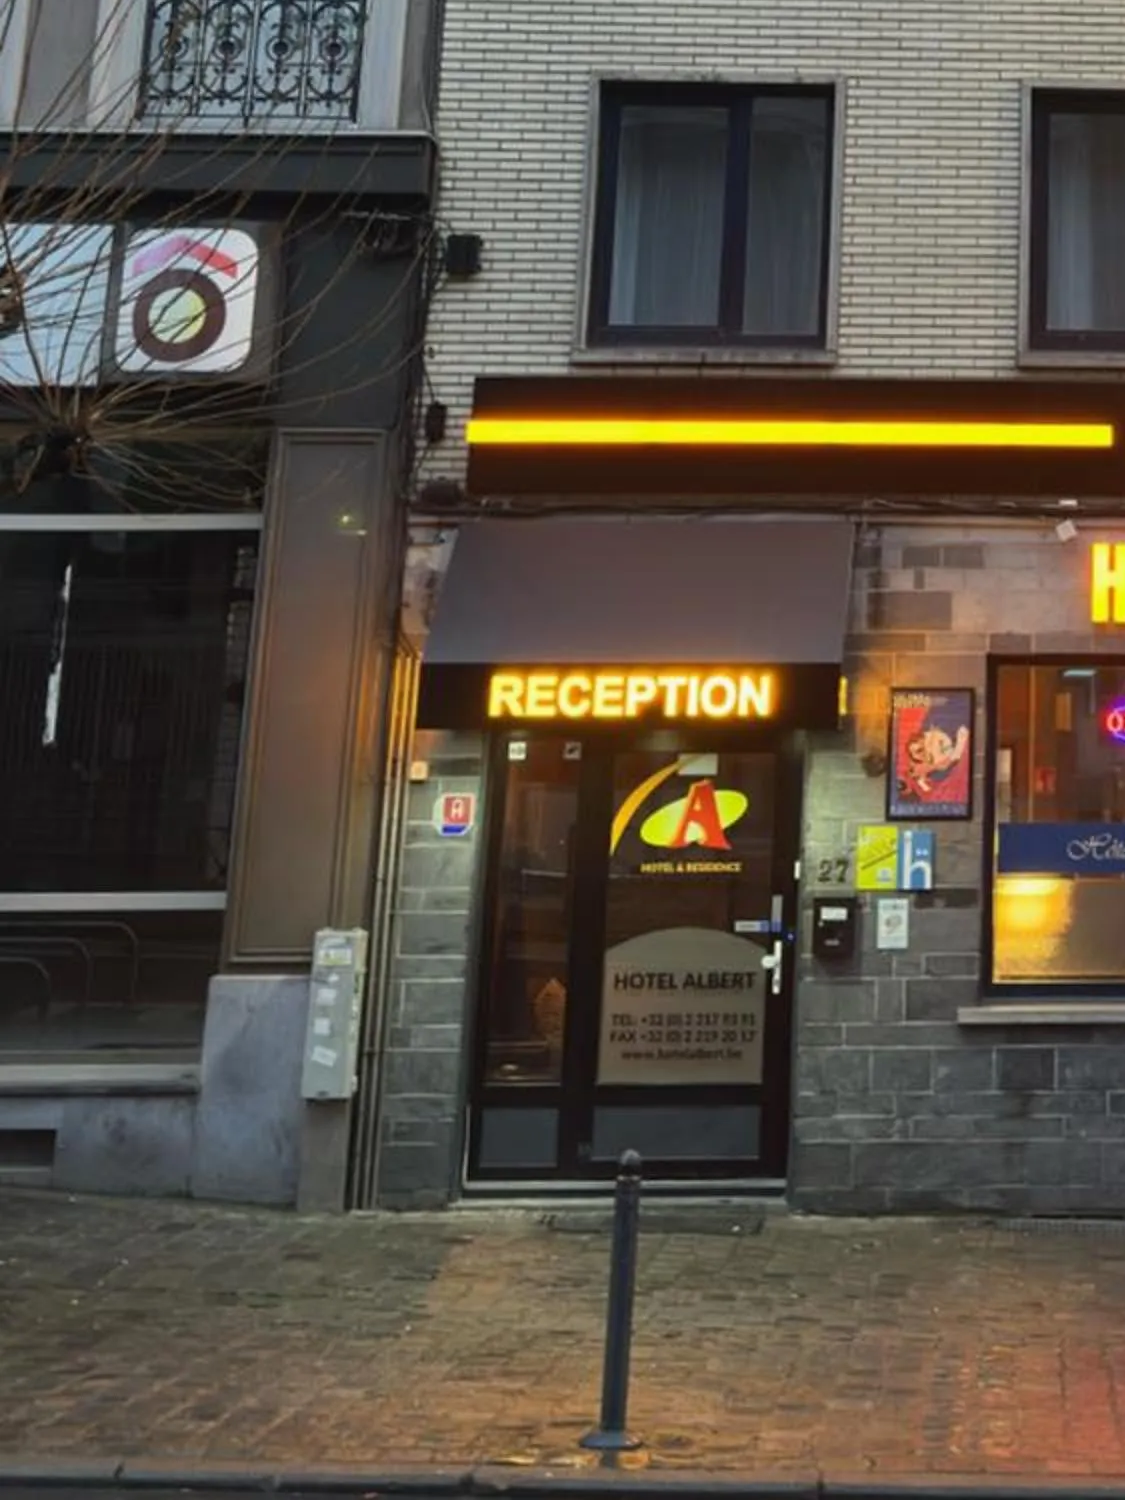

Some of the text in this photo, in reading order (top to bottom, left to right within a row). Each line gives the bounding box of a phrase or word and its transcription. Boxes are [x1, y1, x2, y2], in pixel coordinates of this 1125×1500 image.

[487, 672, 774, 719] RECEPTION
[641, 862, 674, 873] HOTEL
[686, 862, 742, 873] RESIDENCE
[818, 858, 849, 883] 27
[614, 970, 757, 991] HOTEL ALBERT
